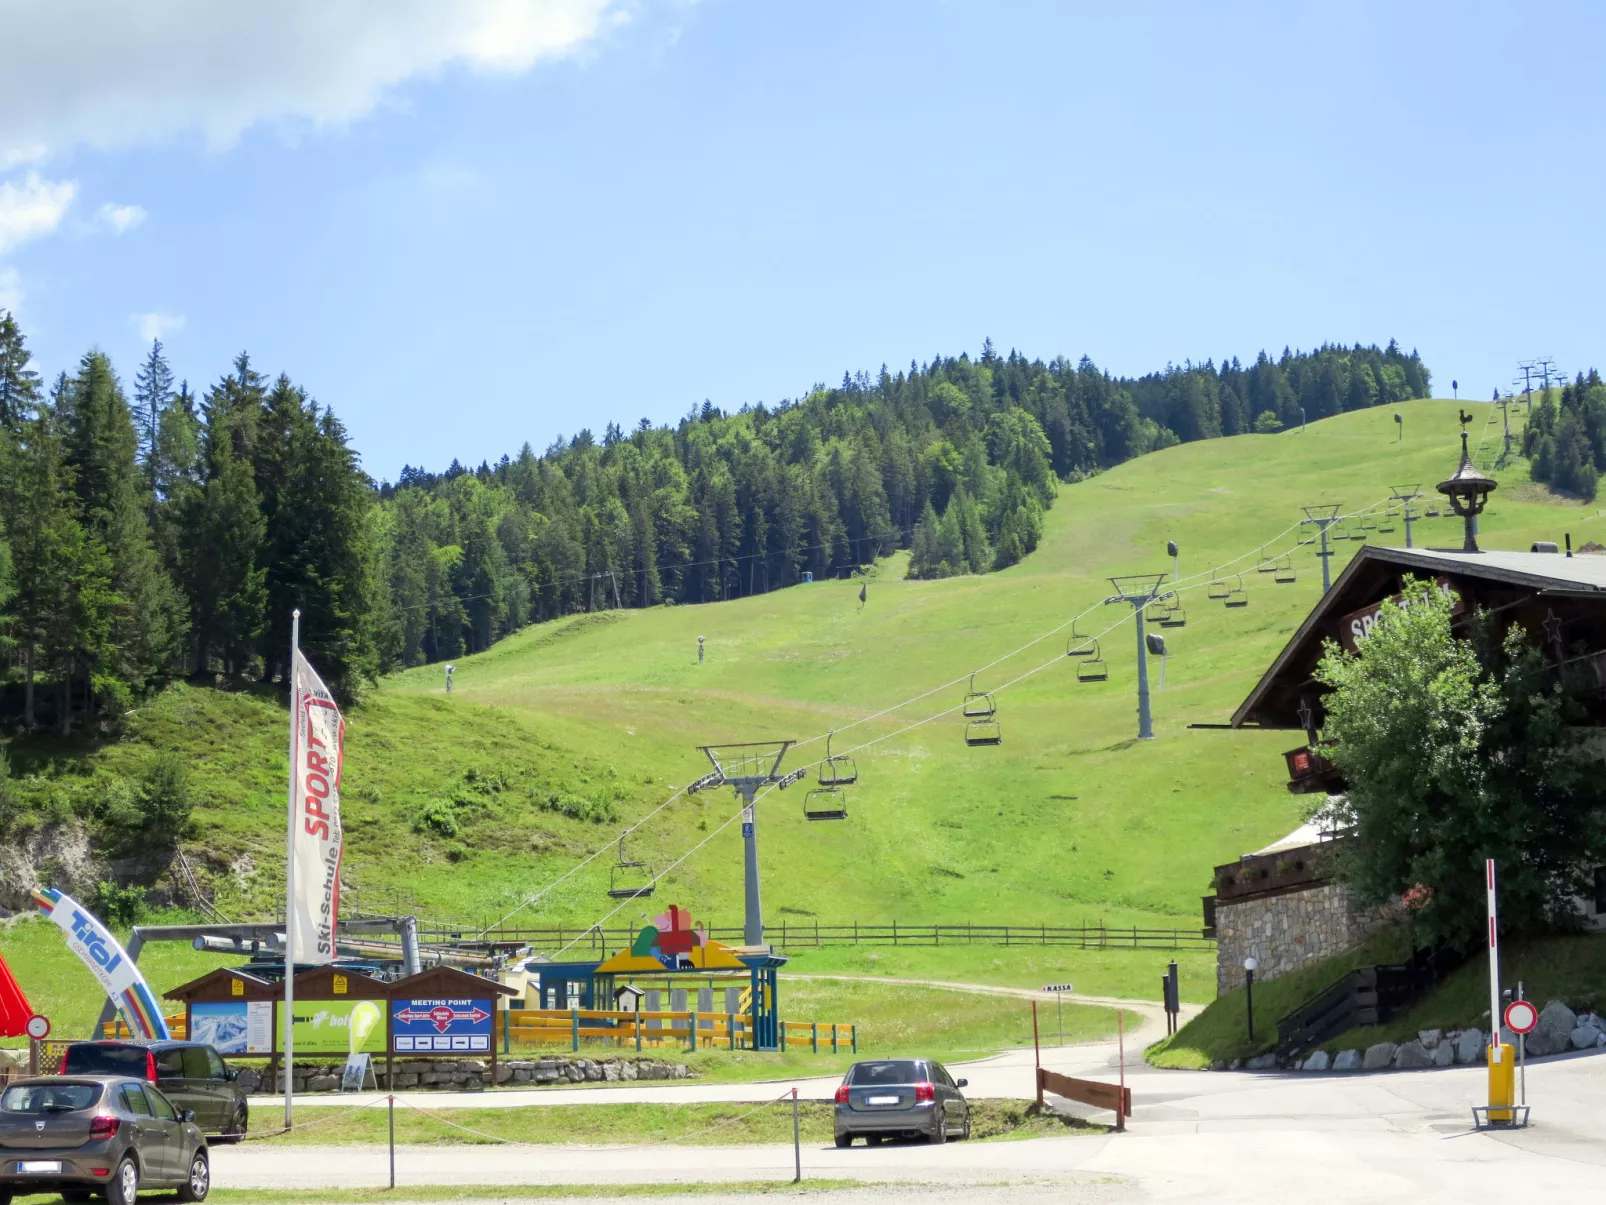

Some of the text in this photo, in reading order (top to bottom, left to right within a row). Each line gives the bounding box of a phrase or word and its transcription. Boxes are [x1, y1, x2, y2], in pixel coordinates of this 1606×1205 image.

[305, 708, 330, 841] SPORT
[319, 847, 338, 954] Ski-Schule
[71, 910, 122, 974] Tirol
[72, 941, 112, 987] GSCHWANDTKOPF
[1047, 984, 1071, 992] KASSA
